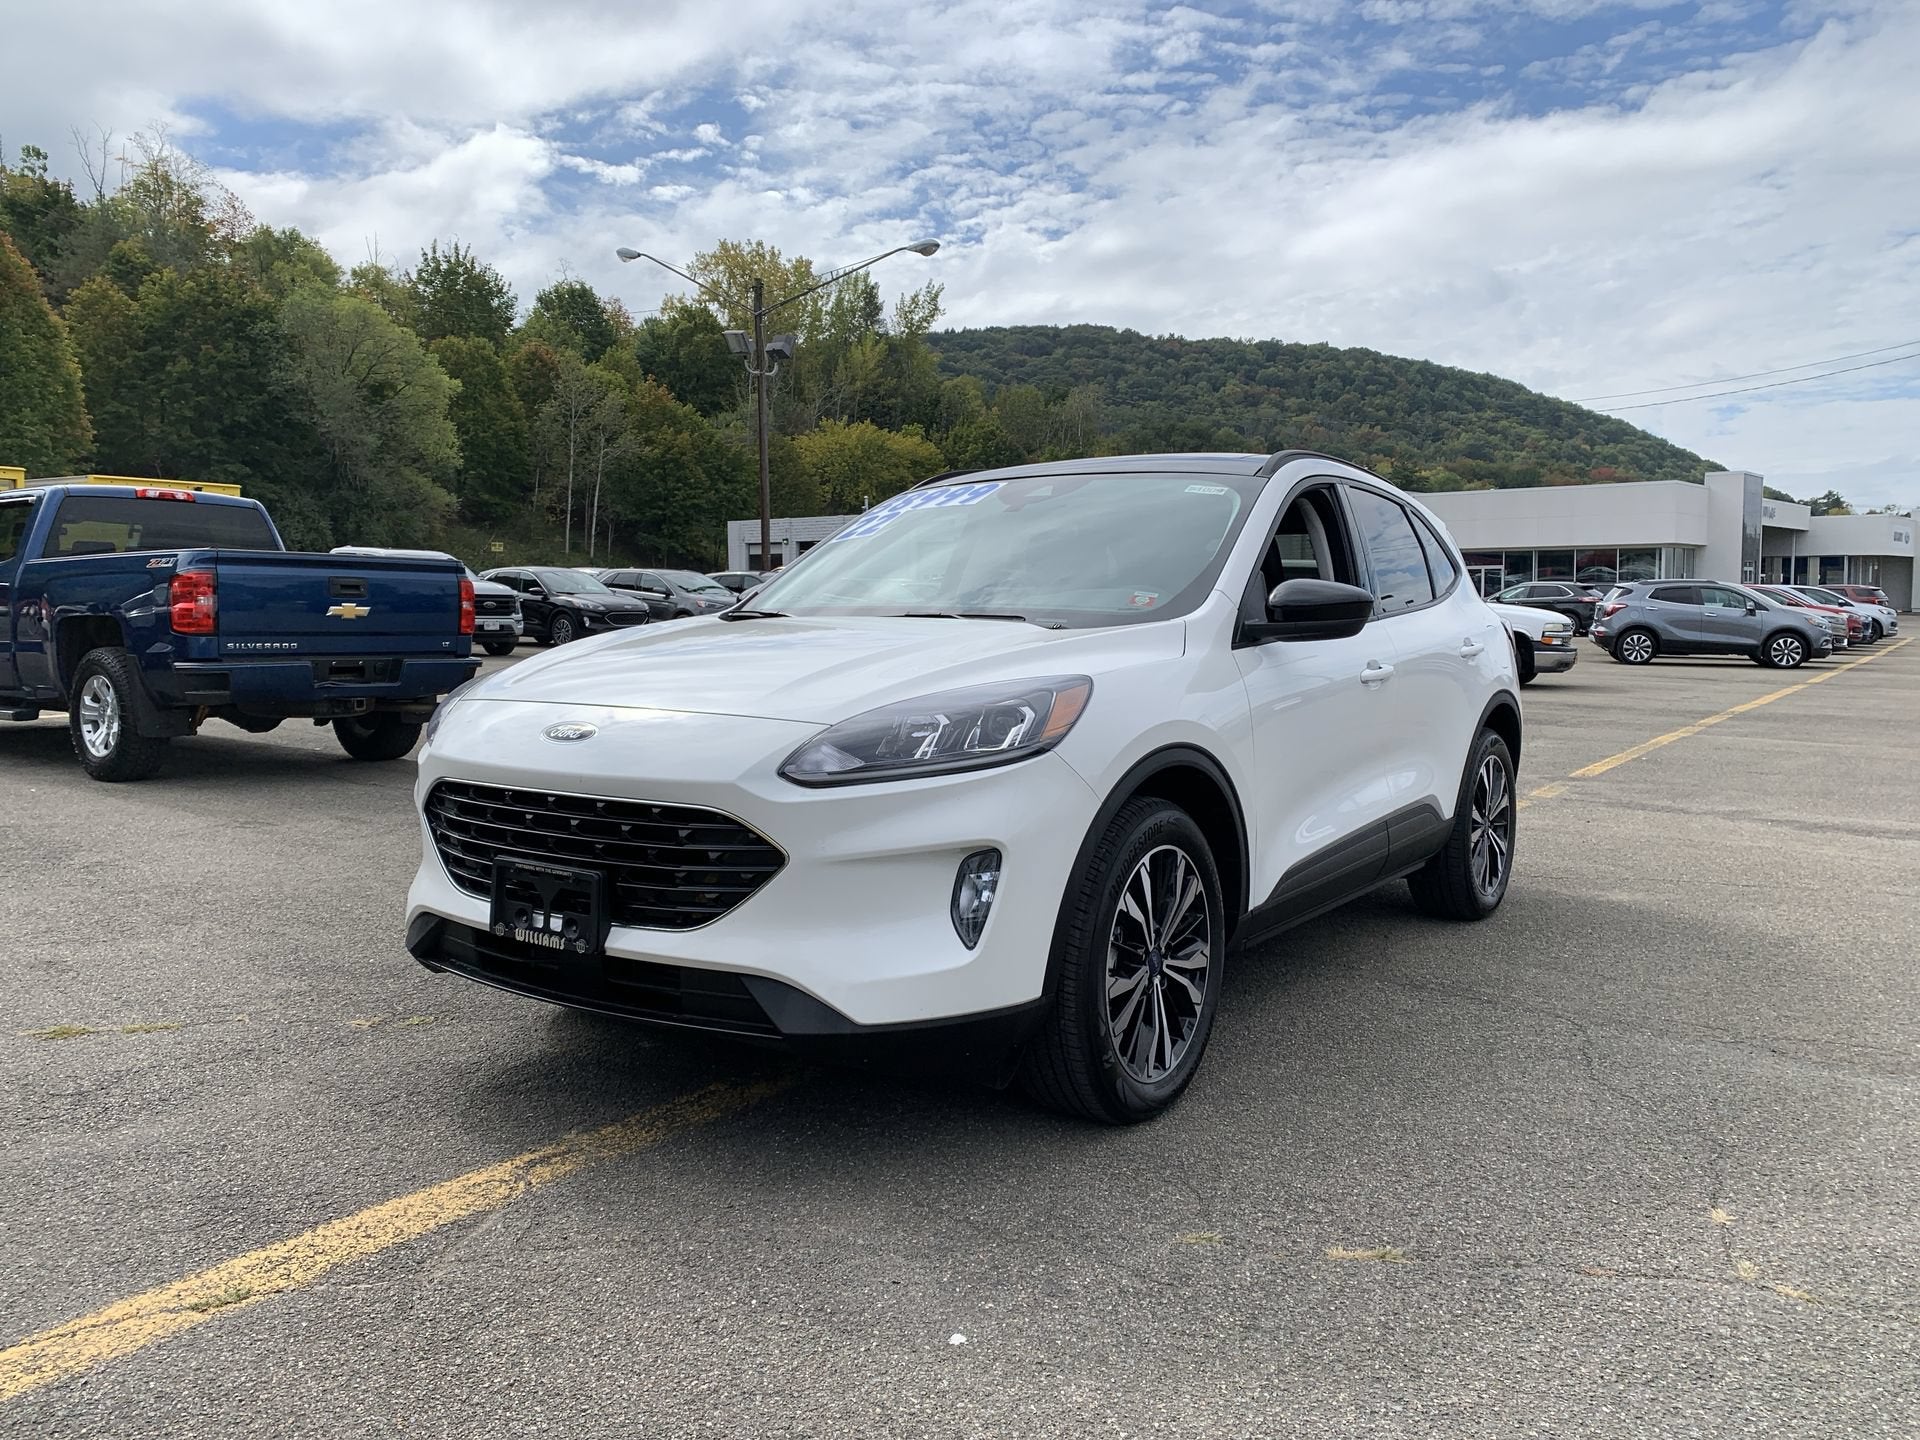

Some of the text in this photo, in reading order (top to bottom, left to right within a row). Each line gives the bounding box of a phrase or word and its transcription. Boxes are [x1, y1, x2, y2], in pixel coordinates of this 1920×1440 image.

[835, 511, 902, 541] 22
[227, 642, 298, 650] SILVERADO
[515, 927, 566, 950] WILLIAMS
